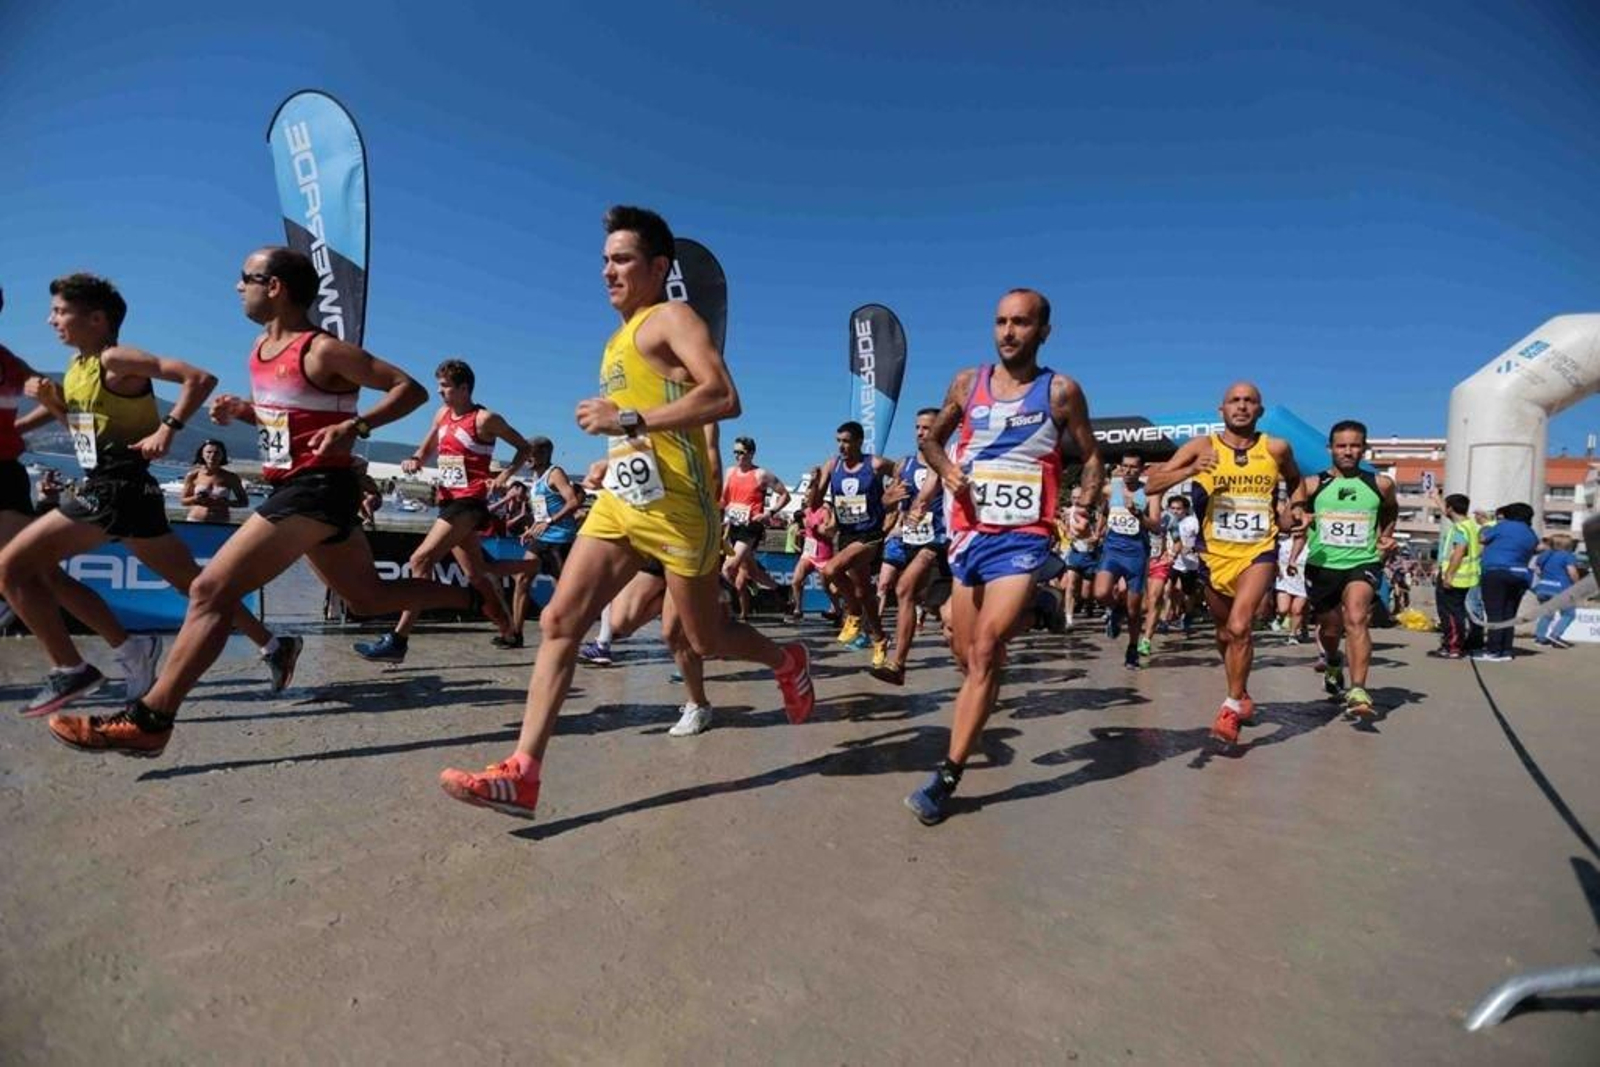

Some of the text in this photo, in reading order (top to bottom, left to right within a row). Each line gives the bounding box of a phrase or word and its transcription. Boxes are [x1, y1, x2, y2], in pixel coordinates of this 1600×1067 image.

[612, 457, 651, 490] 69
[1212, 474, 1272, 486] TANINOS
[976, 483, 1033, 510] 158
[1218, 511, 1264, 531] 151
[1330, 522, 1358, 537] 81
